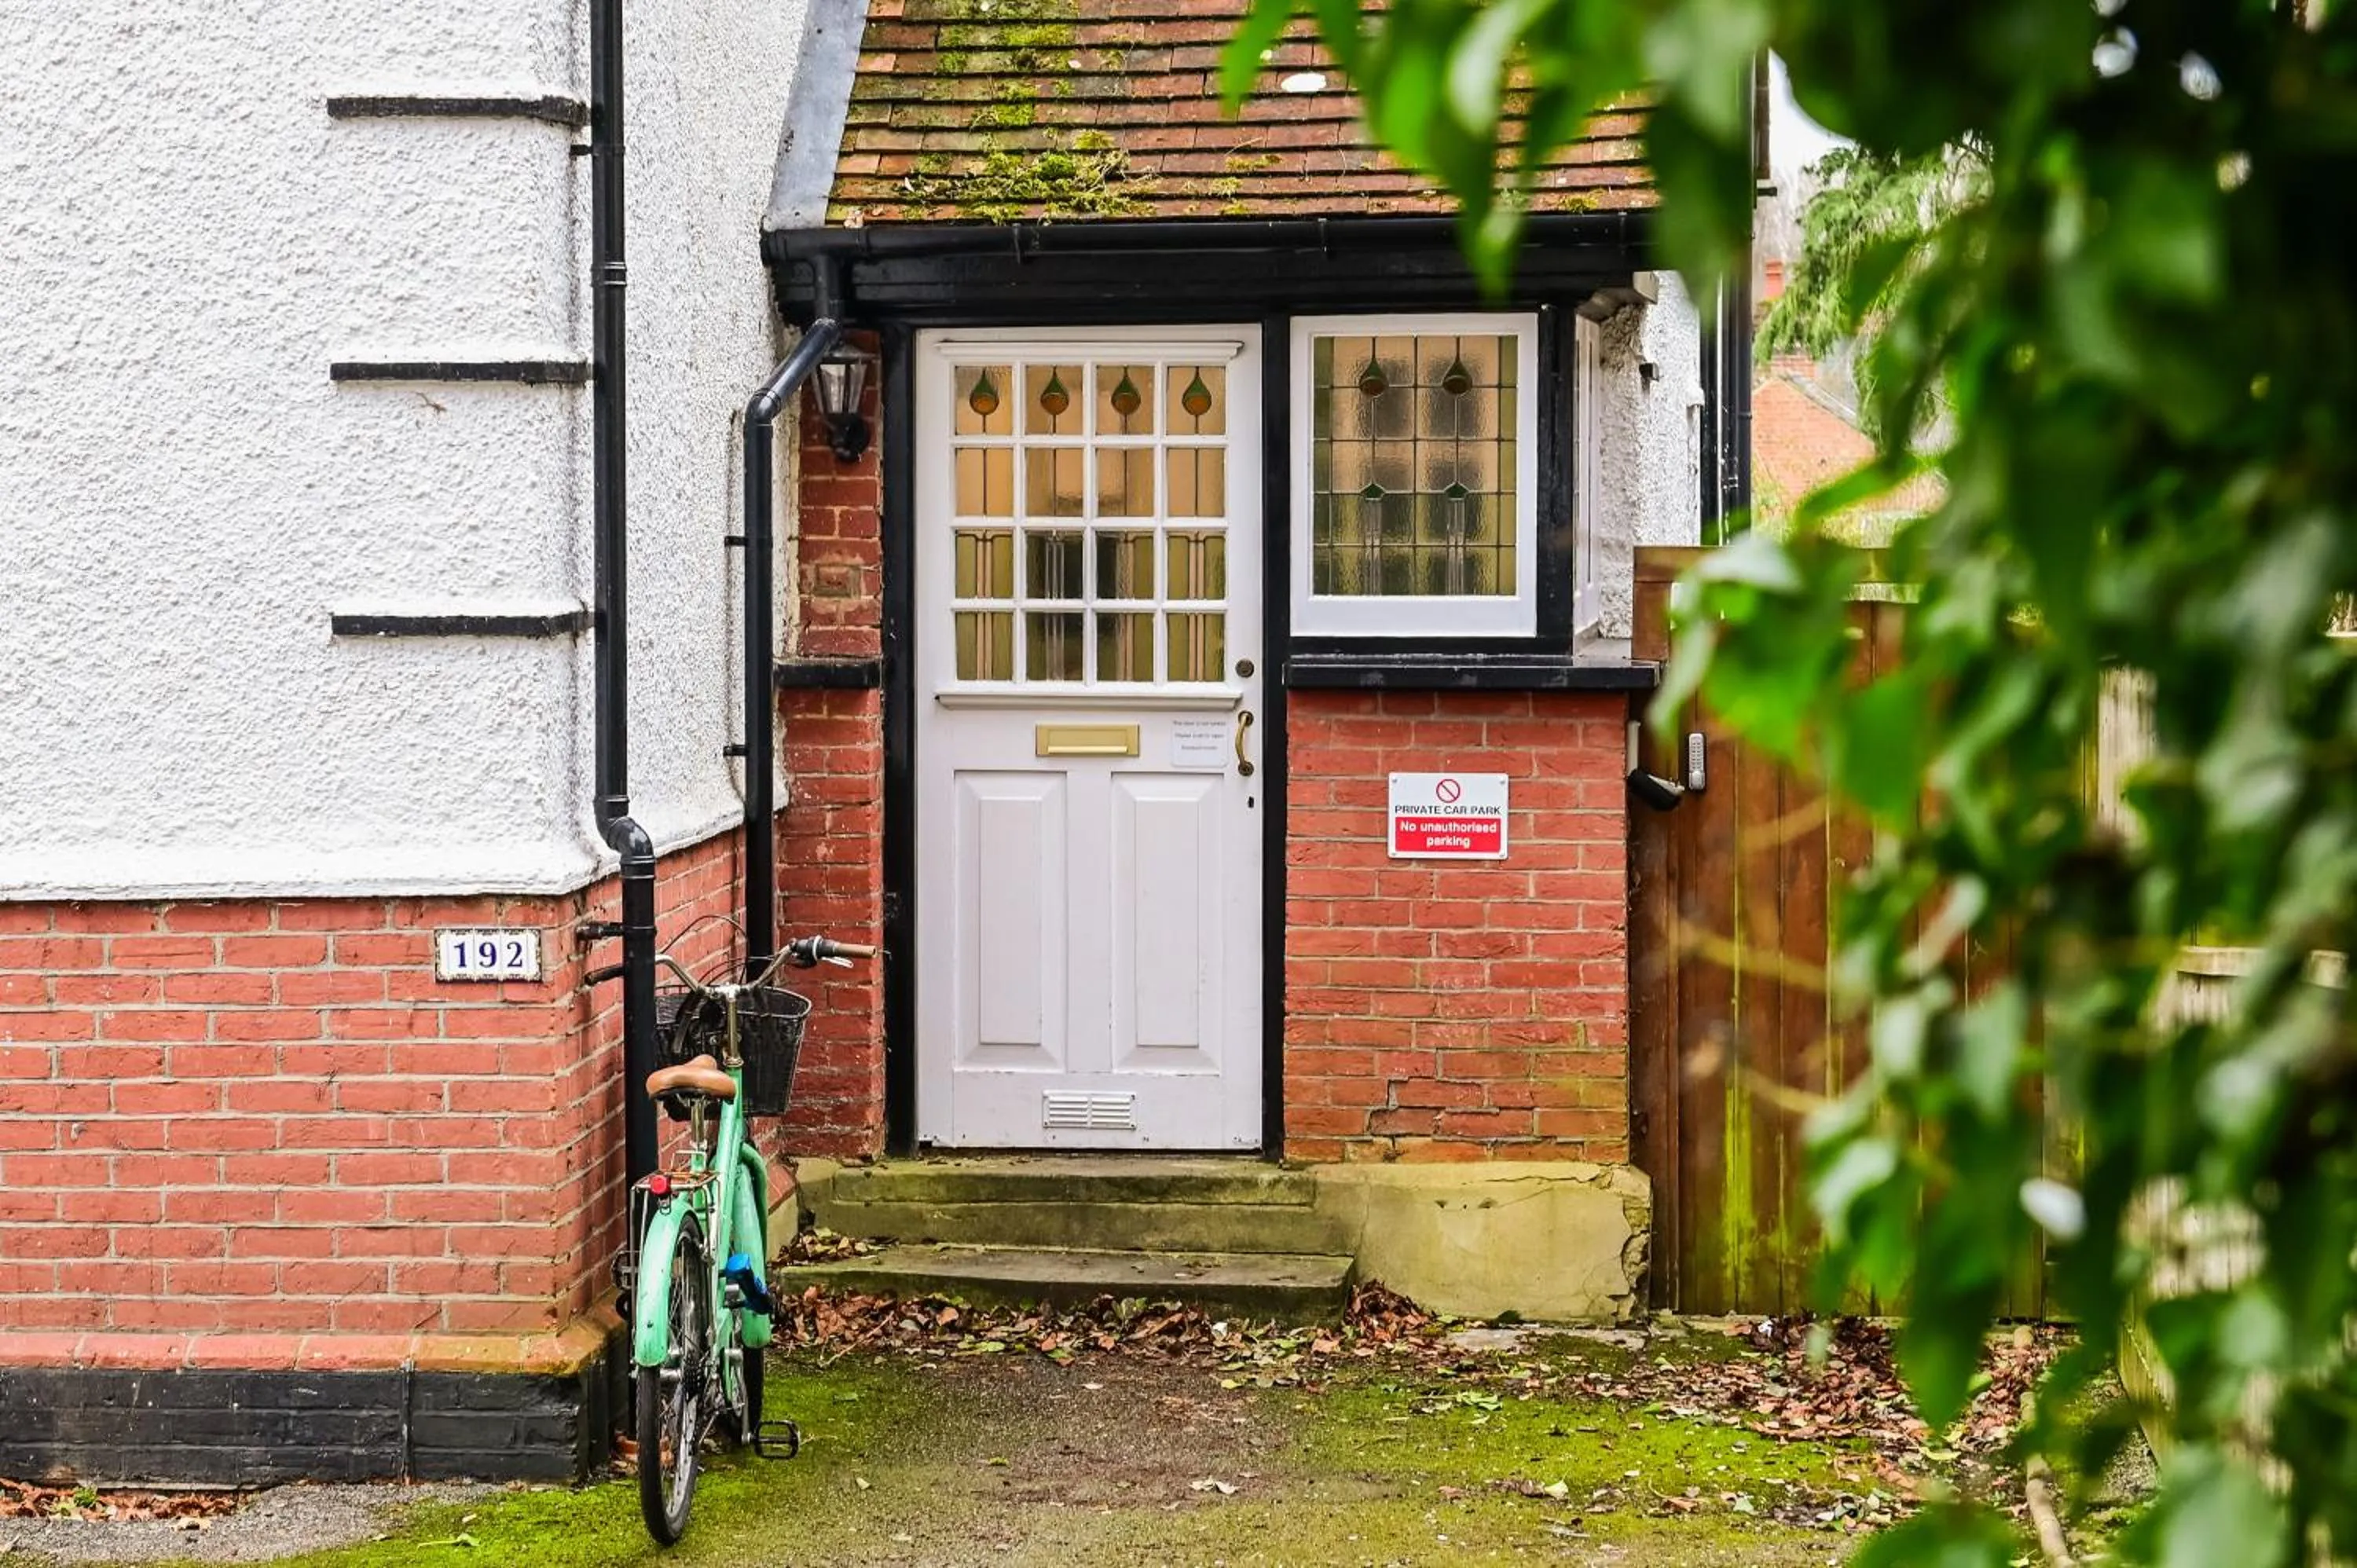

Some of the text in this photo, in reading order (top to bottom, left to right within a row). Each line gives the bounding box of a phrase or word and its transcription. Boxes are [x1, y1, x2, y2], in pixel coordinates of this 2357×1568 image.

[1395, 805, 1501, 815] PRIVATE CAR PARK
[1400, 821, 1497, 833] No unauthorised
[1426, 836, 1471, 848] parking
[453, 942, 522, 968] 192
